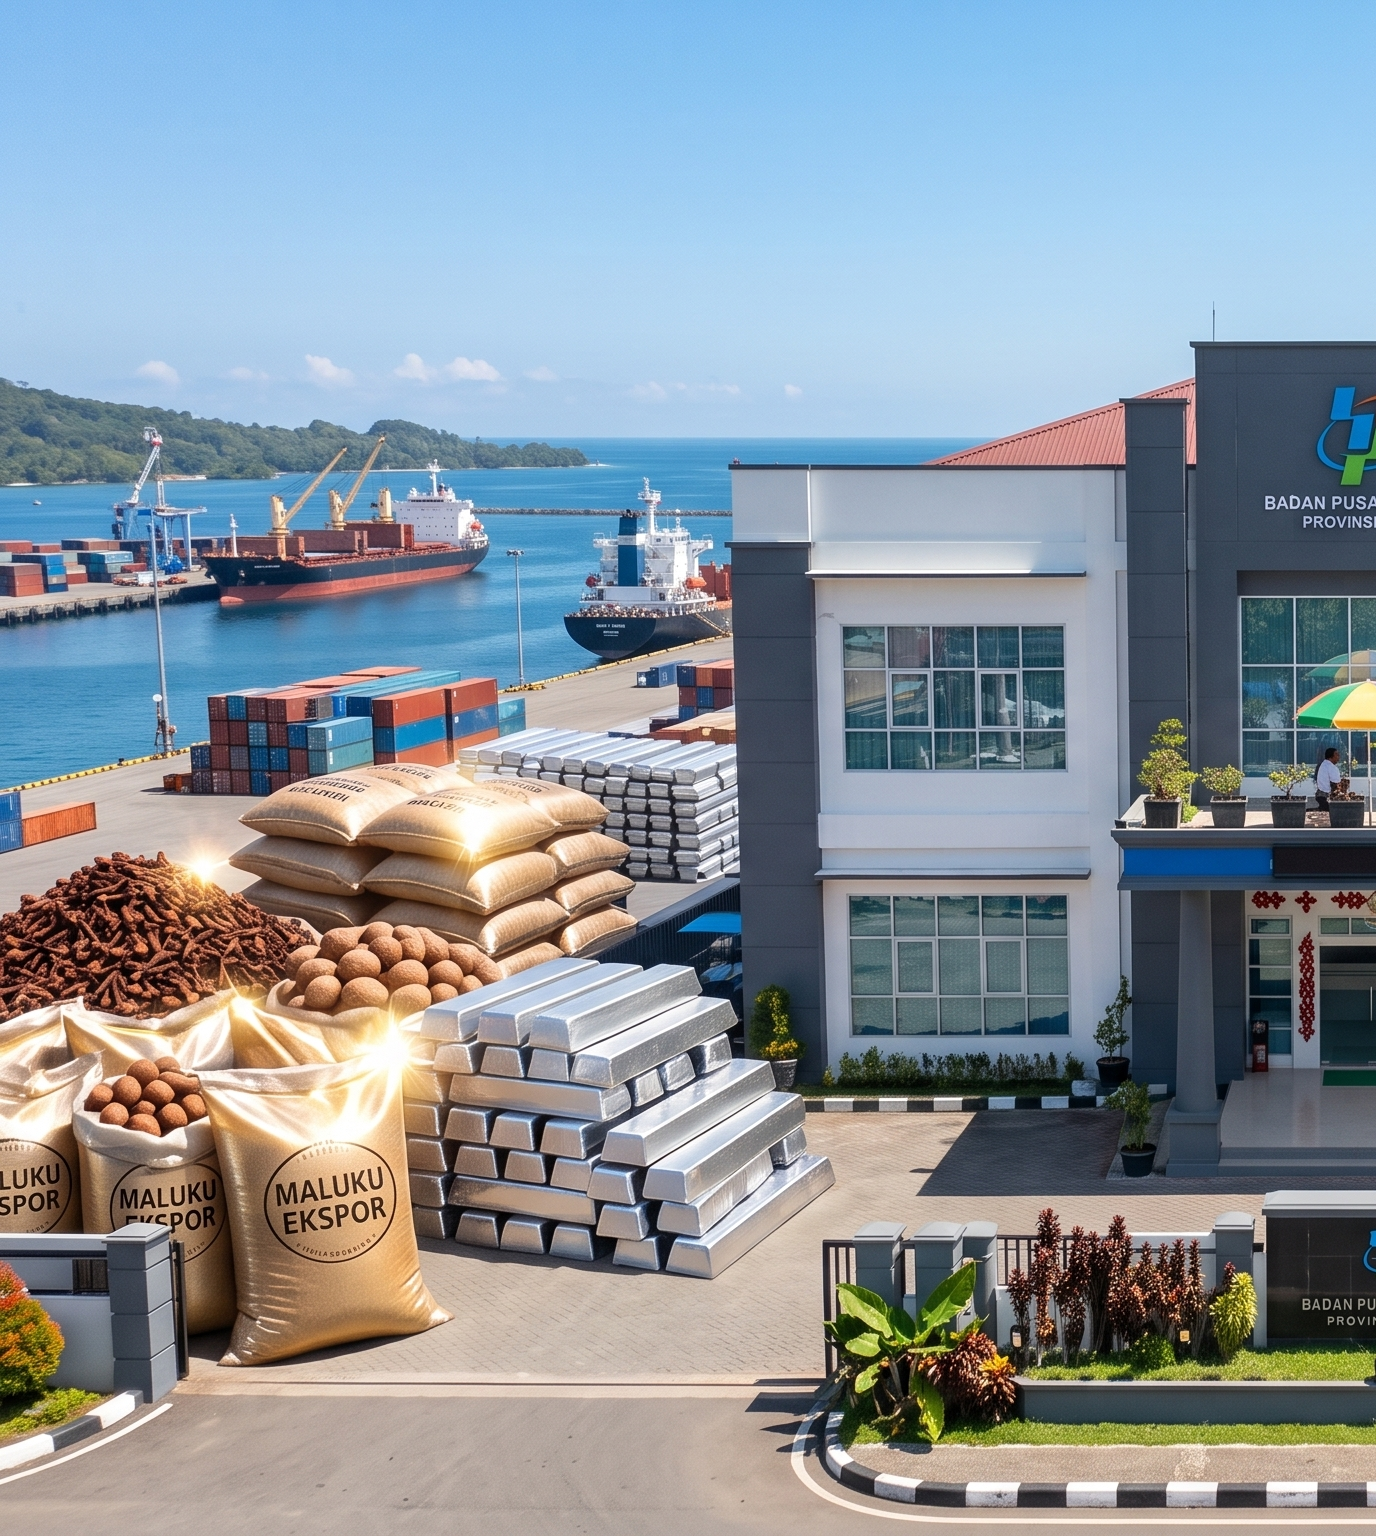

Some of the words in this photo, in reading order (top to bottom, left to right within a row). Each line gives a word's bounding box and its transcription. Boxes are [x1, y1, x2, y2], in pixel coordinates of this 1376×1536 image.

[1264, 494, 1326, 510] BADAN
[120, 1179, 217, 1209] MALUKU
[274, 1166, 384, 1207] MALUKU
[283, 1196, 387, 1235] EKSPOR
[1302, 1298, 1352, 1311] BADAN
